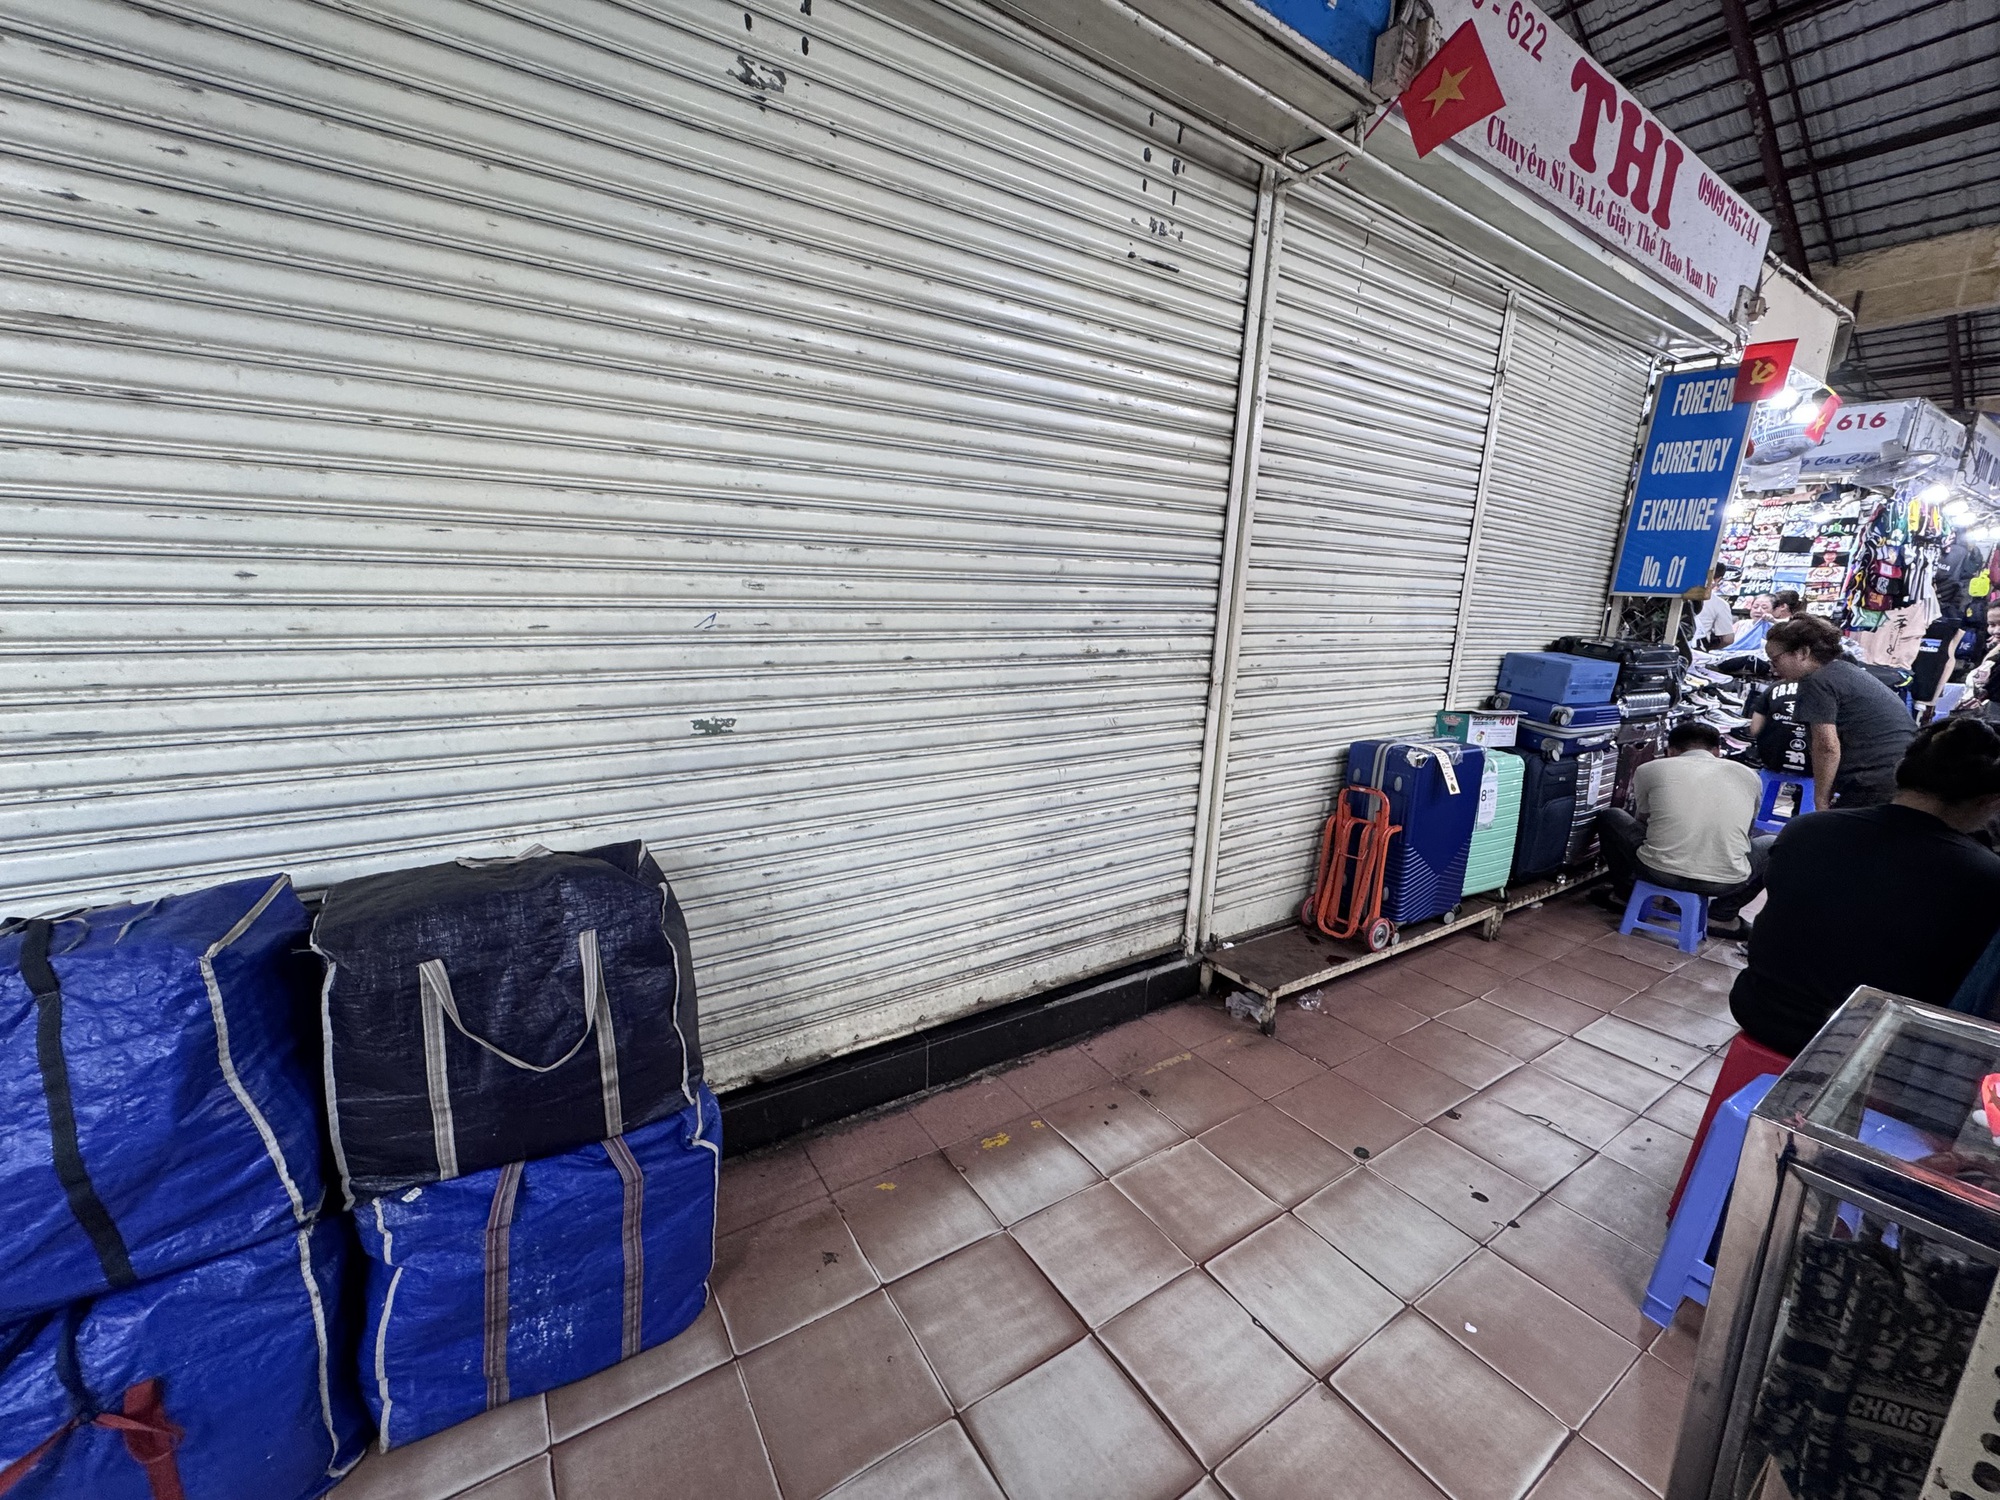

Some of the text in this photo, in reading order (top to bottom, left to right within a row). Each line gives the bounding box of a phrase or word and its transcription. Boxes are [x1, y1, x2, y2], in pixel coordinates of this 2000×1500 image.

[1507, 1, 1547, 63] 622
[1569, 57, 1684, 230] THI
[1487, 115, 1547, 181] Chuyên
[1587, 185, 1605, 220] Lẻ
[1607, 200, 1635, 246] Giày
[1636, 220, 1660, 256] Thể
[1659, 237, 1683, 275] Thao
[1683, 256, 1703, 291] Nam
[1698, 172, 1760, 247] 0909795744
[1836, 411, 1887, 431] 616
[1651, 438, 1733, 475] CURRENCY
[1814, 456, 1842, 466] Cao
[1637, 498, 1718, 531] EXCHANGE
[1639, 555, 1687, 588] No. 01
[1499, 715, 1516, 726] 400
[1480, 790, 1487, 802] 8
